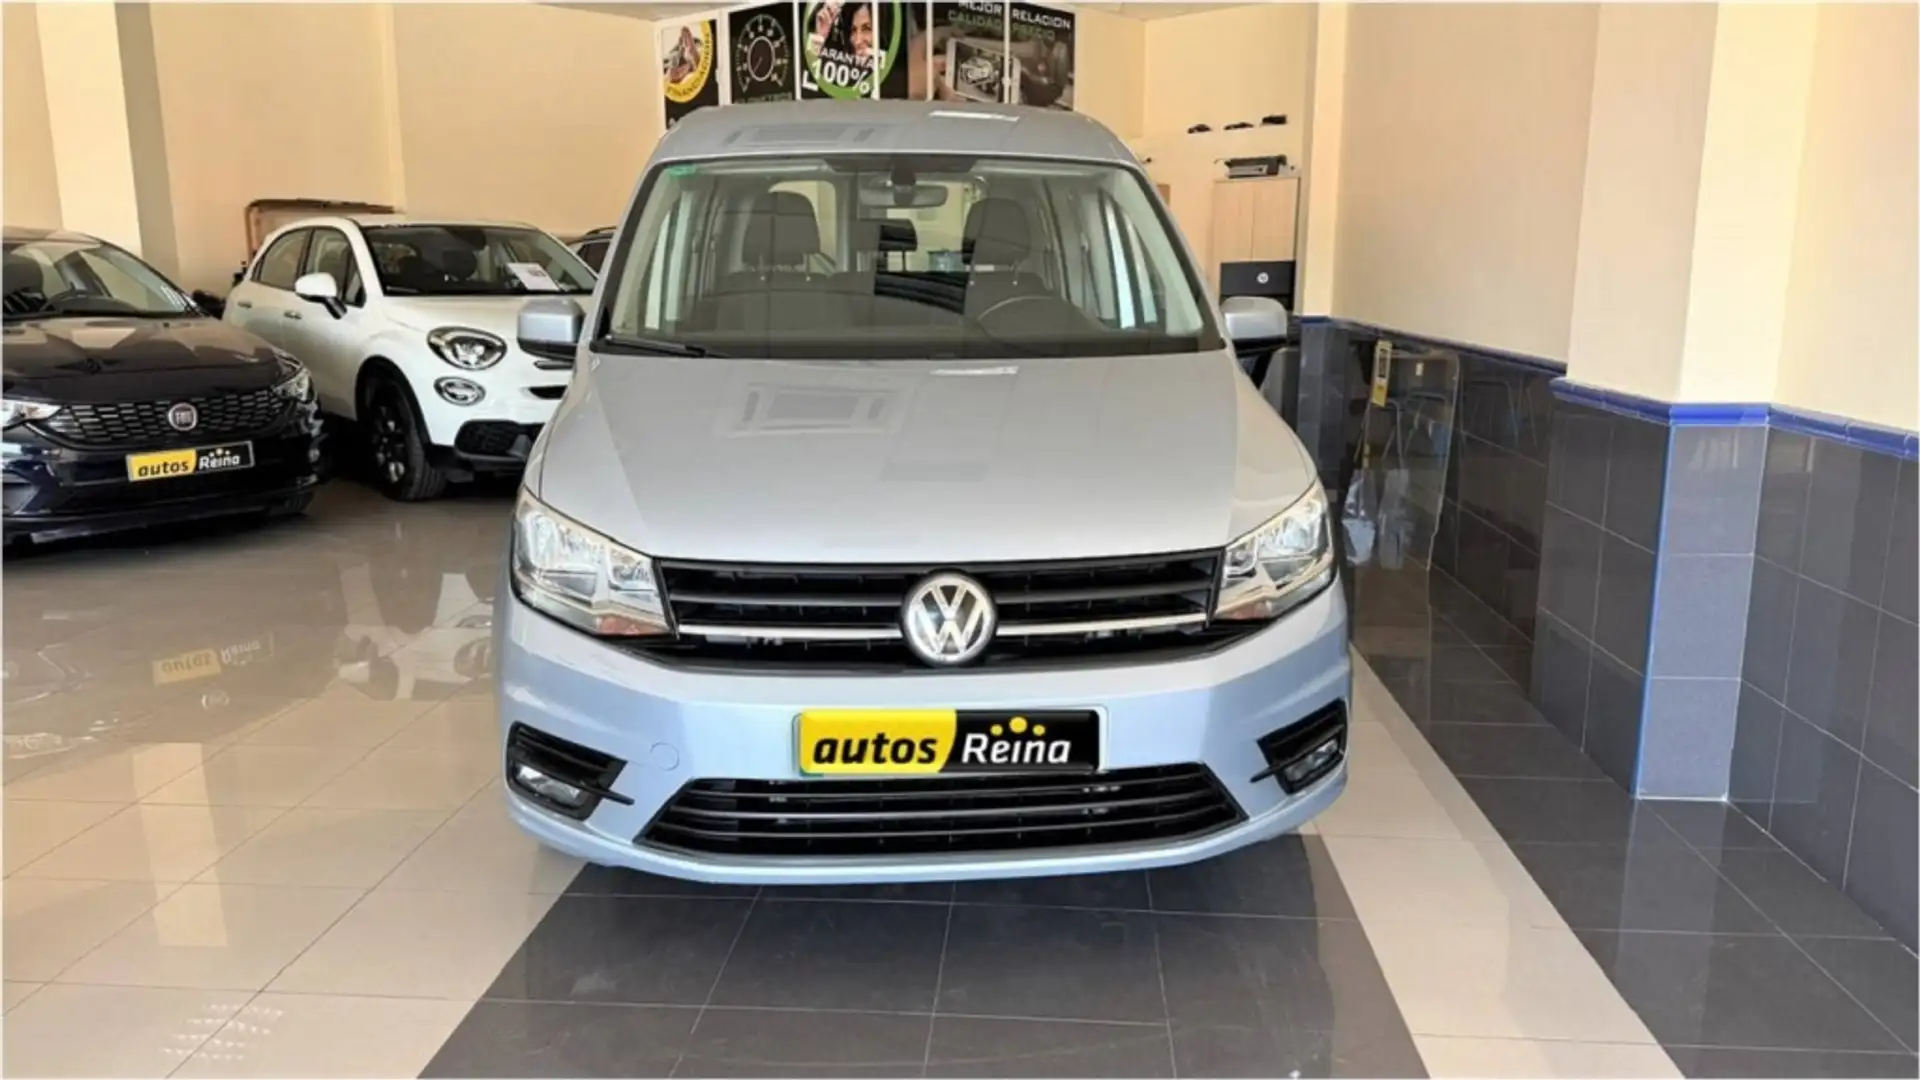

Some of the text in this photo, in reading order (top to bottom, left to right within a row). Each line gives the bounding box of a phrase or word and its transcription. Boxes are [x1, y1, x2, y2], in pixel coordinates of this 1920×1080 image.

[948, 9, 1003, 29] CALIDAD
[958, 0, 1071, 30] MEJOR RELACION
[811, 59, 870, 95] 100%
[138, 454, 241, 477] autos Reina
[812, 732, 1072, 765] autos Reina
